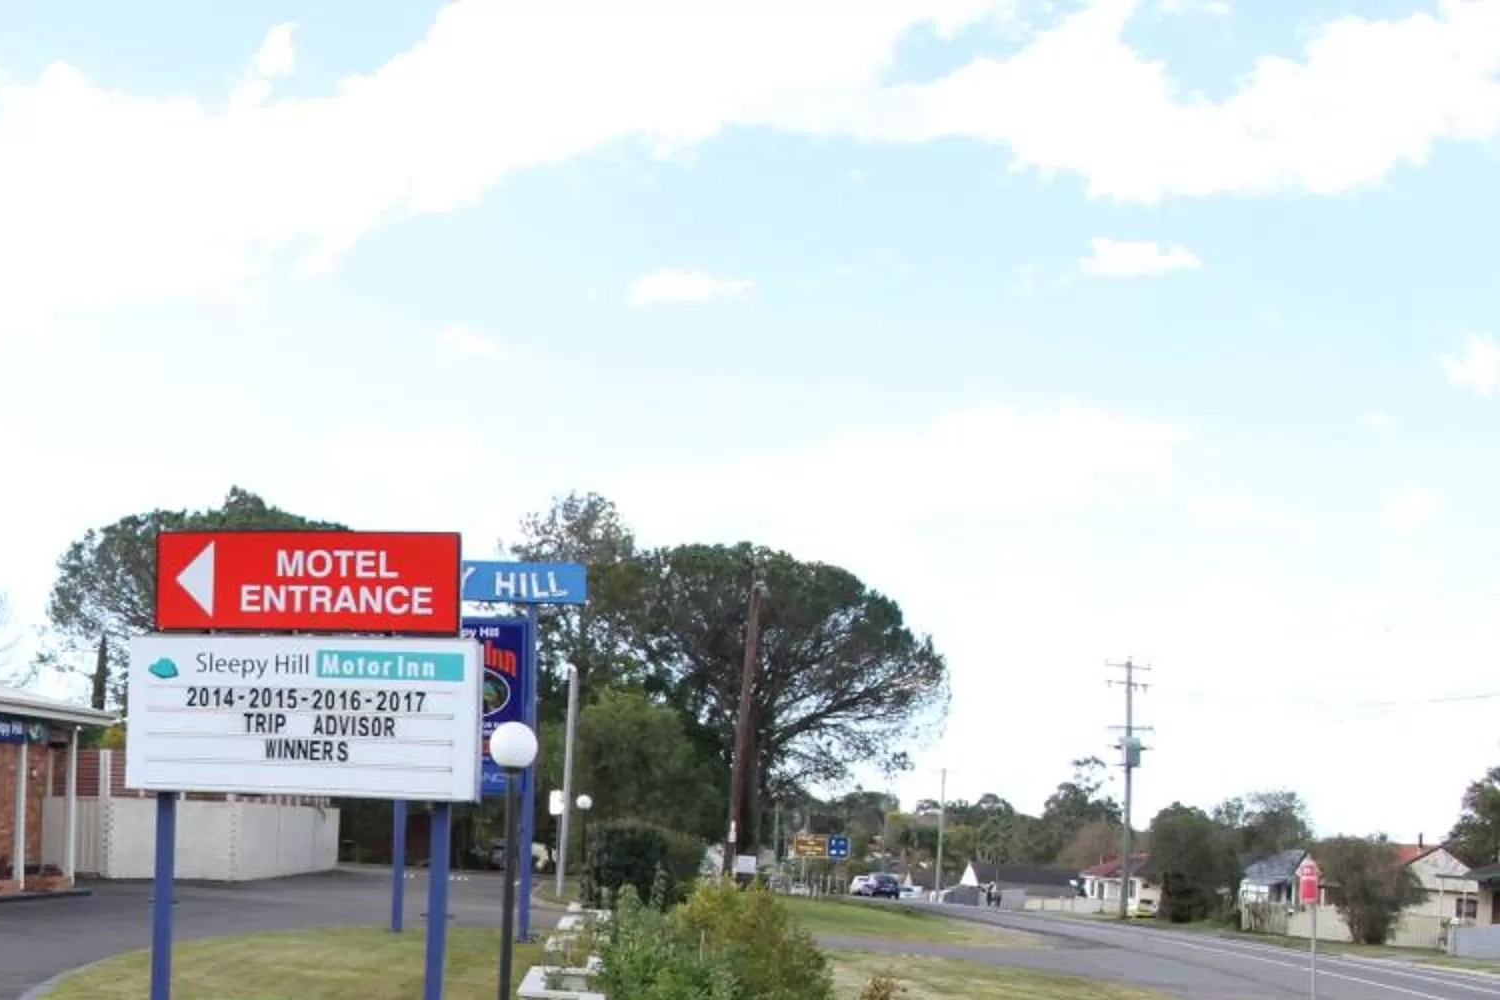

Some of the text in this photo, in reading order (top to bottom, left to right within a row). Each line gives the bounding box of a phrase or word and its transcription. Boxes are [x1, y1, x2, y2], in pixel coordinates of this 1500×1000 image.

[276, 549, 398, 578] MOTEL
[495, 571, 568, 598] HILL
[240, 585, 433, 614] ENTRANCE
[195, 653, 435, 678] Sleepy Hill Motor Inn
[186, 686, 426, 713] 2014-2015-2016-2017
[244, 713, 395, 737] TRIP ADVISOR
[264, 738, 349, 761] WINNERS
